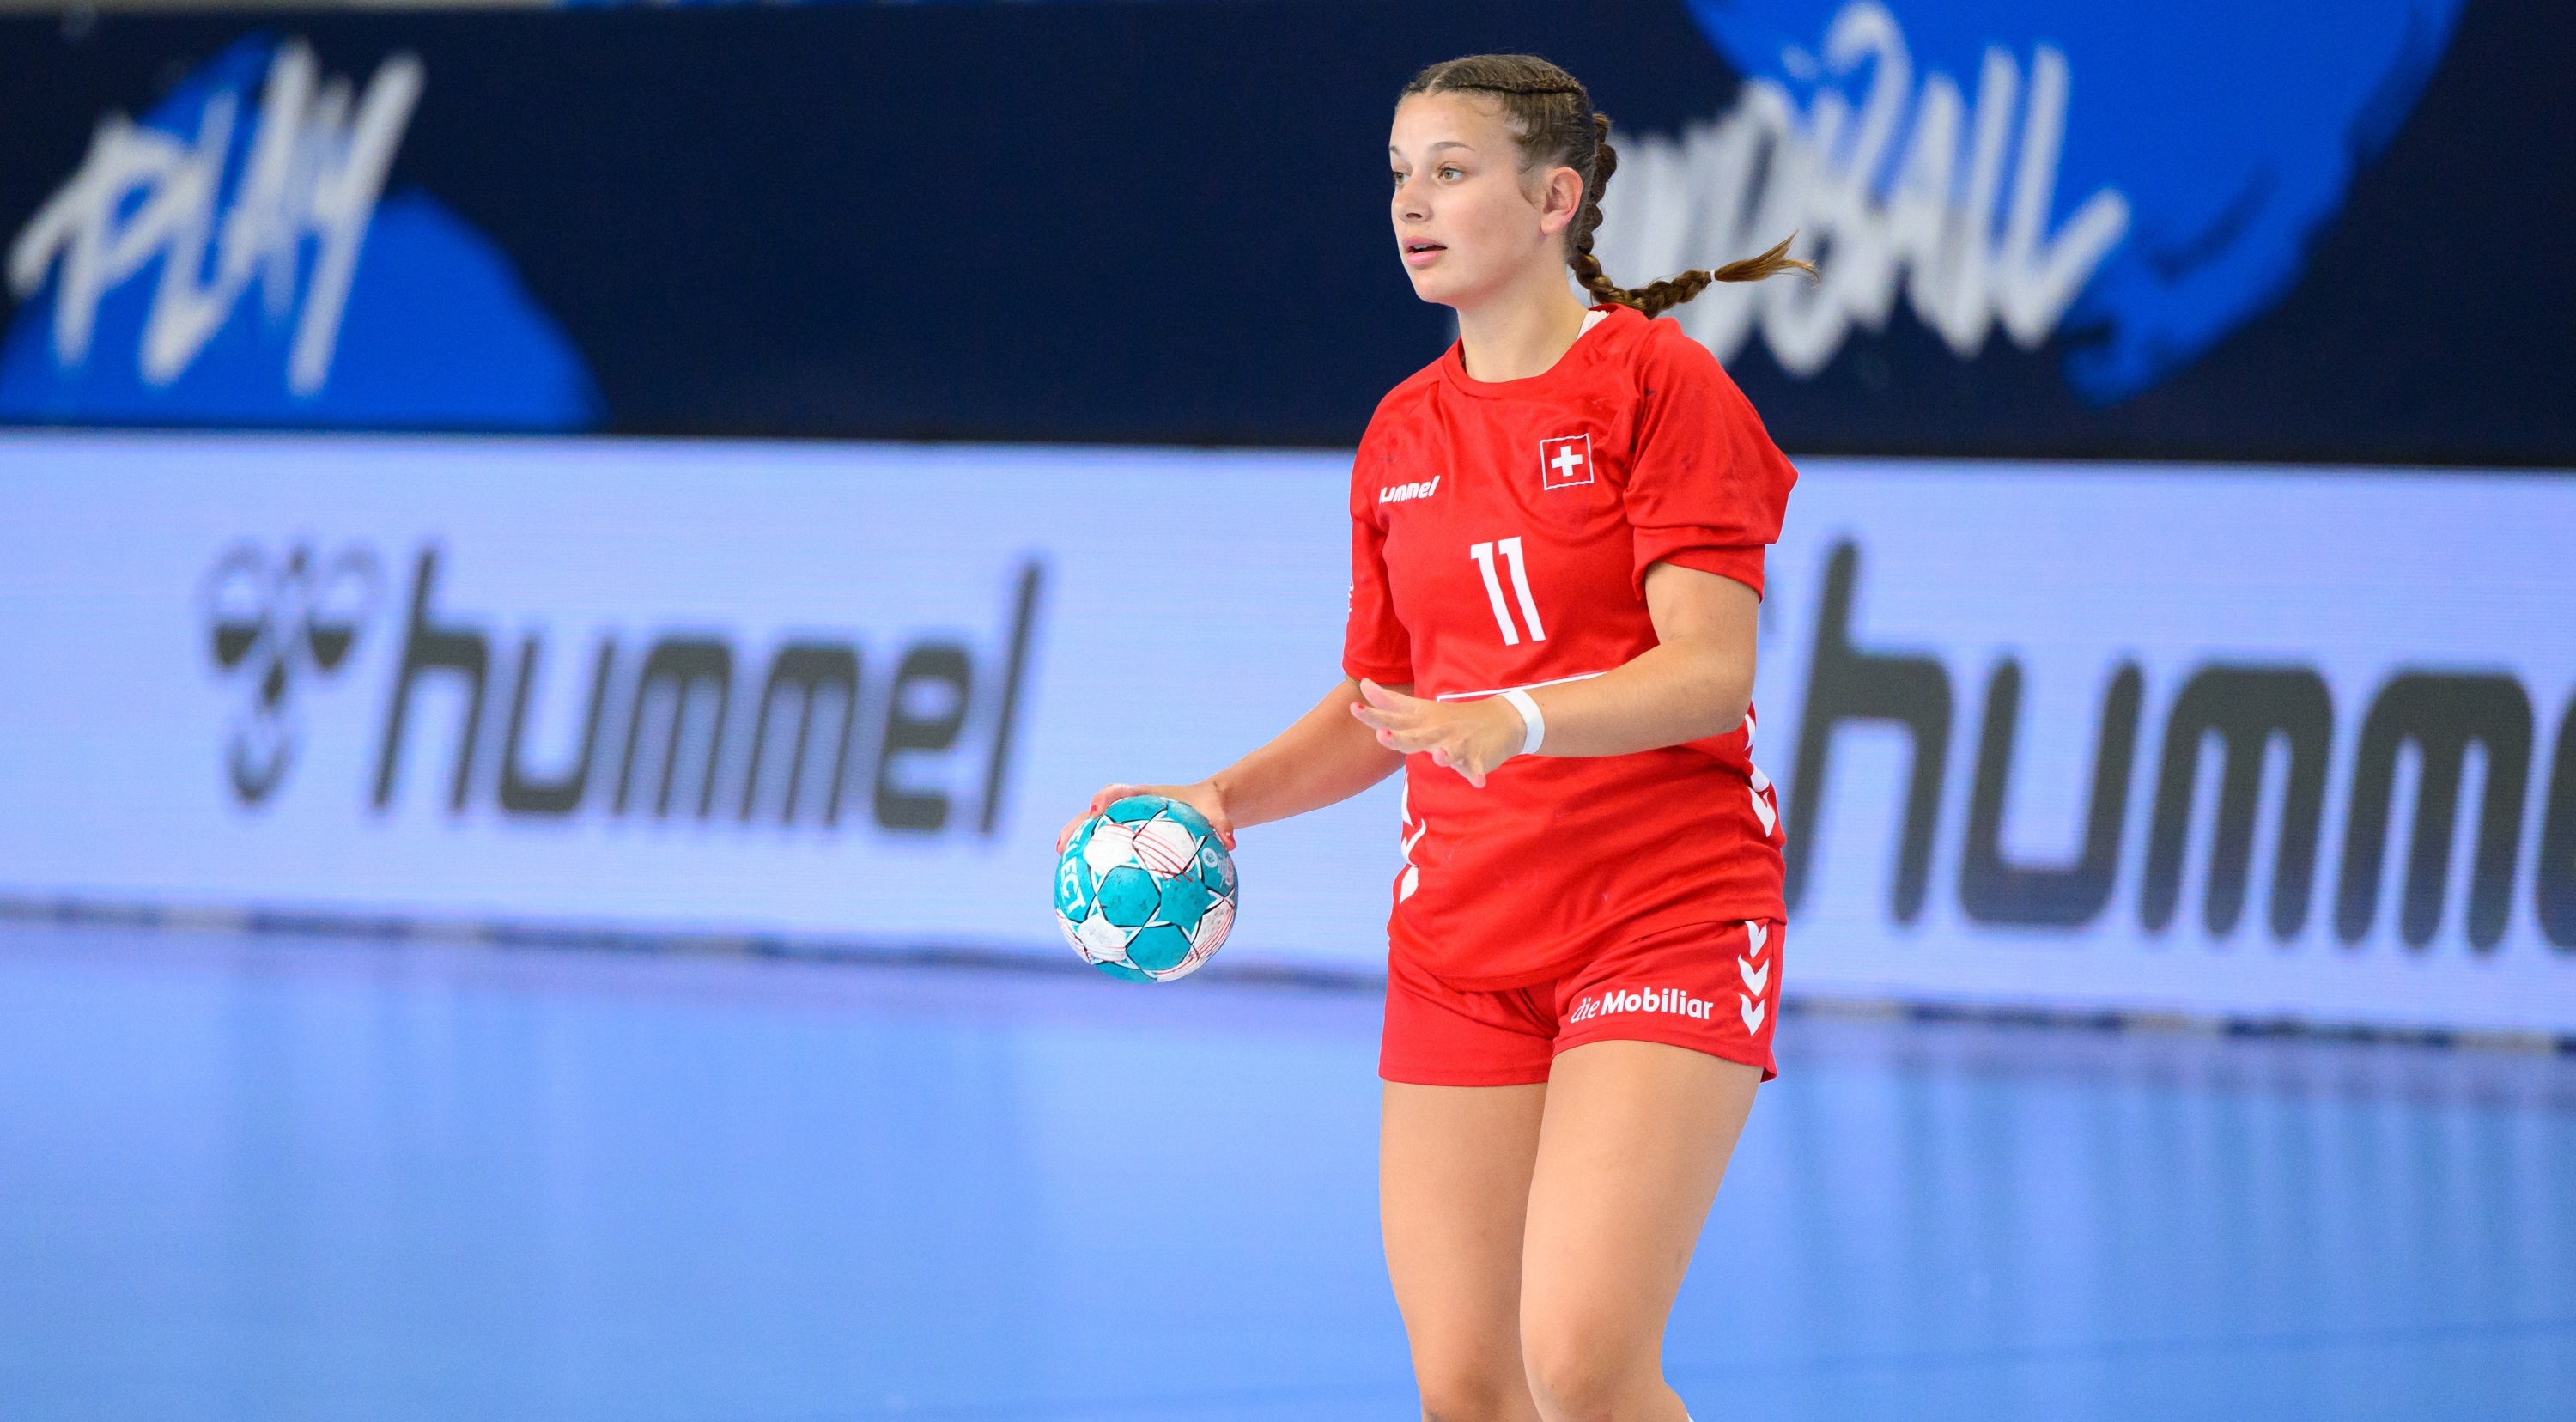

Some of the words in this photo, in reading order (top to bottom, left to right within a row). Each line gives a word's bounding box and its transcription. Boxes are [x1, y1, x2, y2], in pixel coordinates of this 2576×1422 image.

[7, 36, 426, 400] PLAY
[1470, 536, 1546, 646] 11
[368, 546, 1046, 838] hummel
[1570, 995, 1601, 1024] die
[1600, 987, 1714, 1021] Mobiliar
